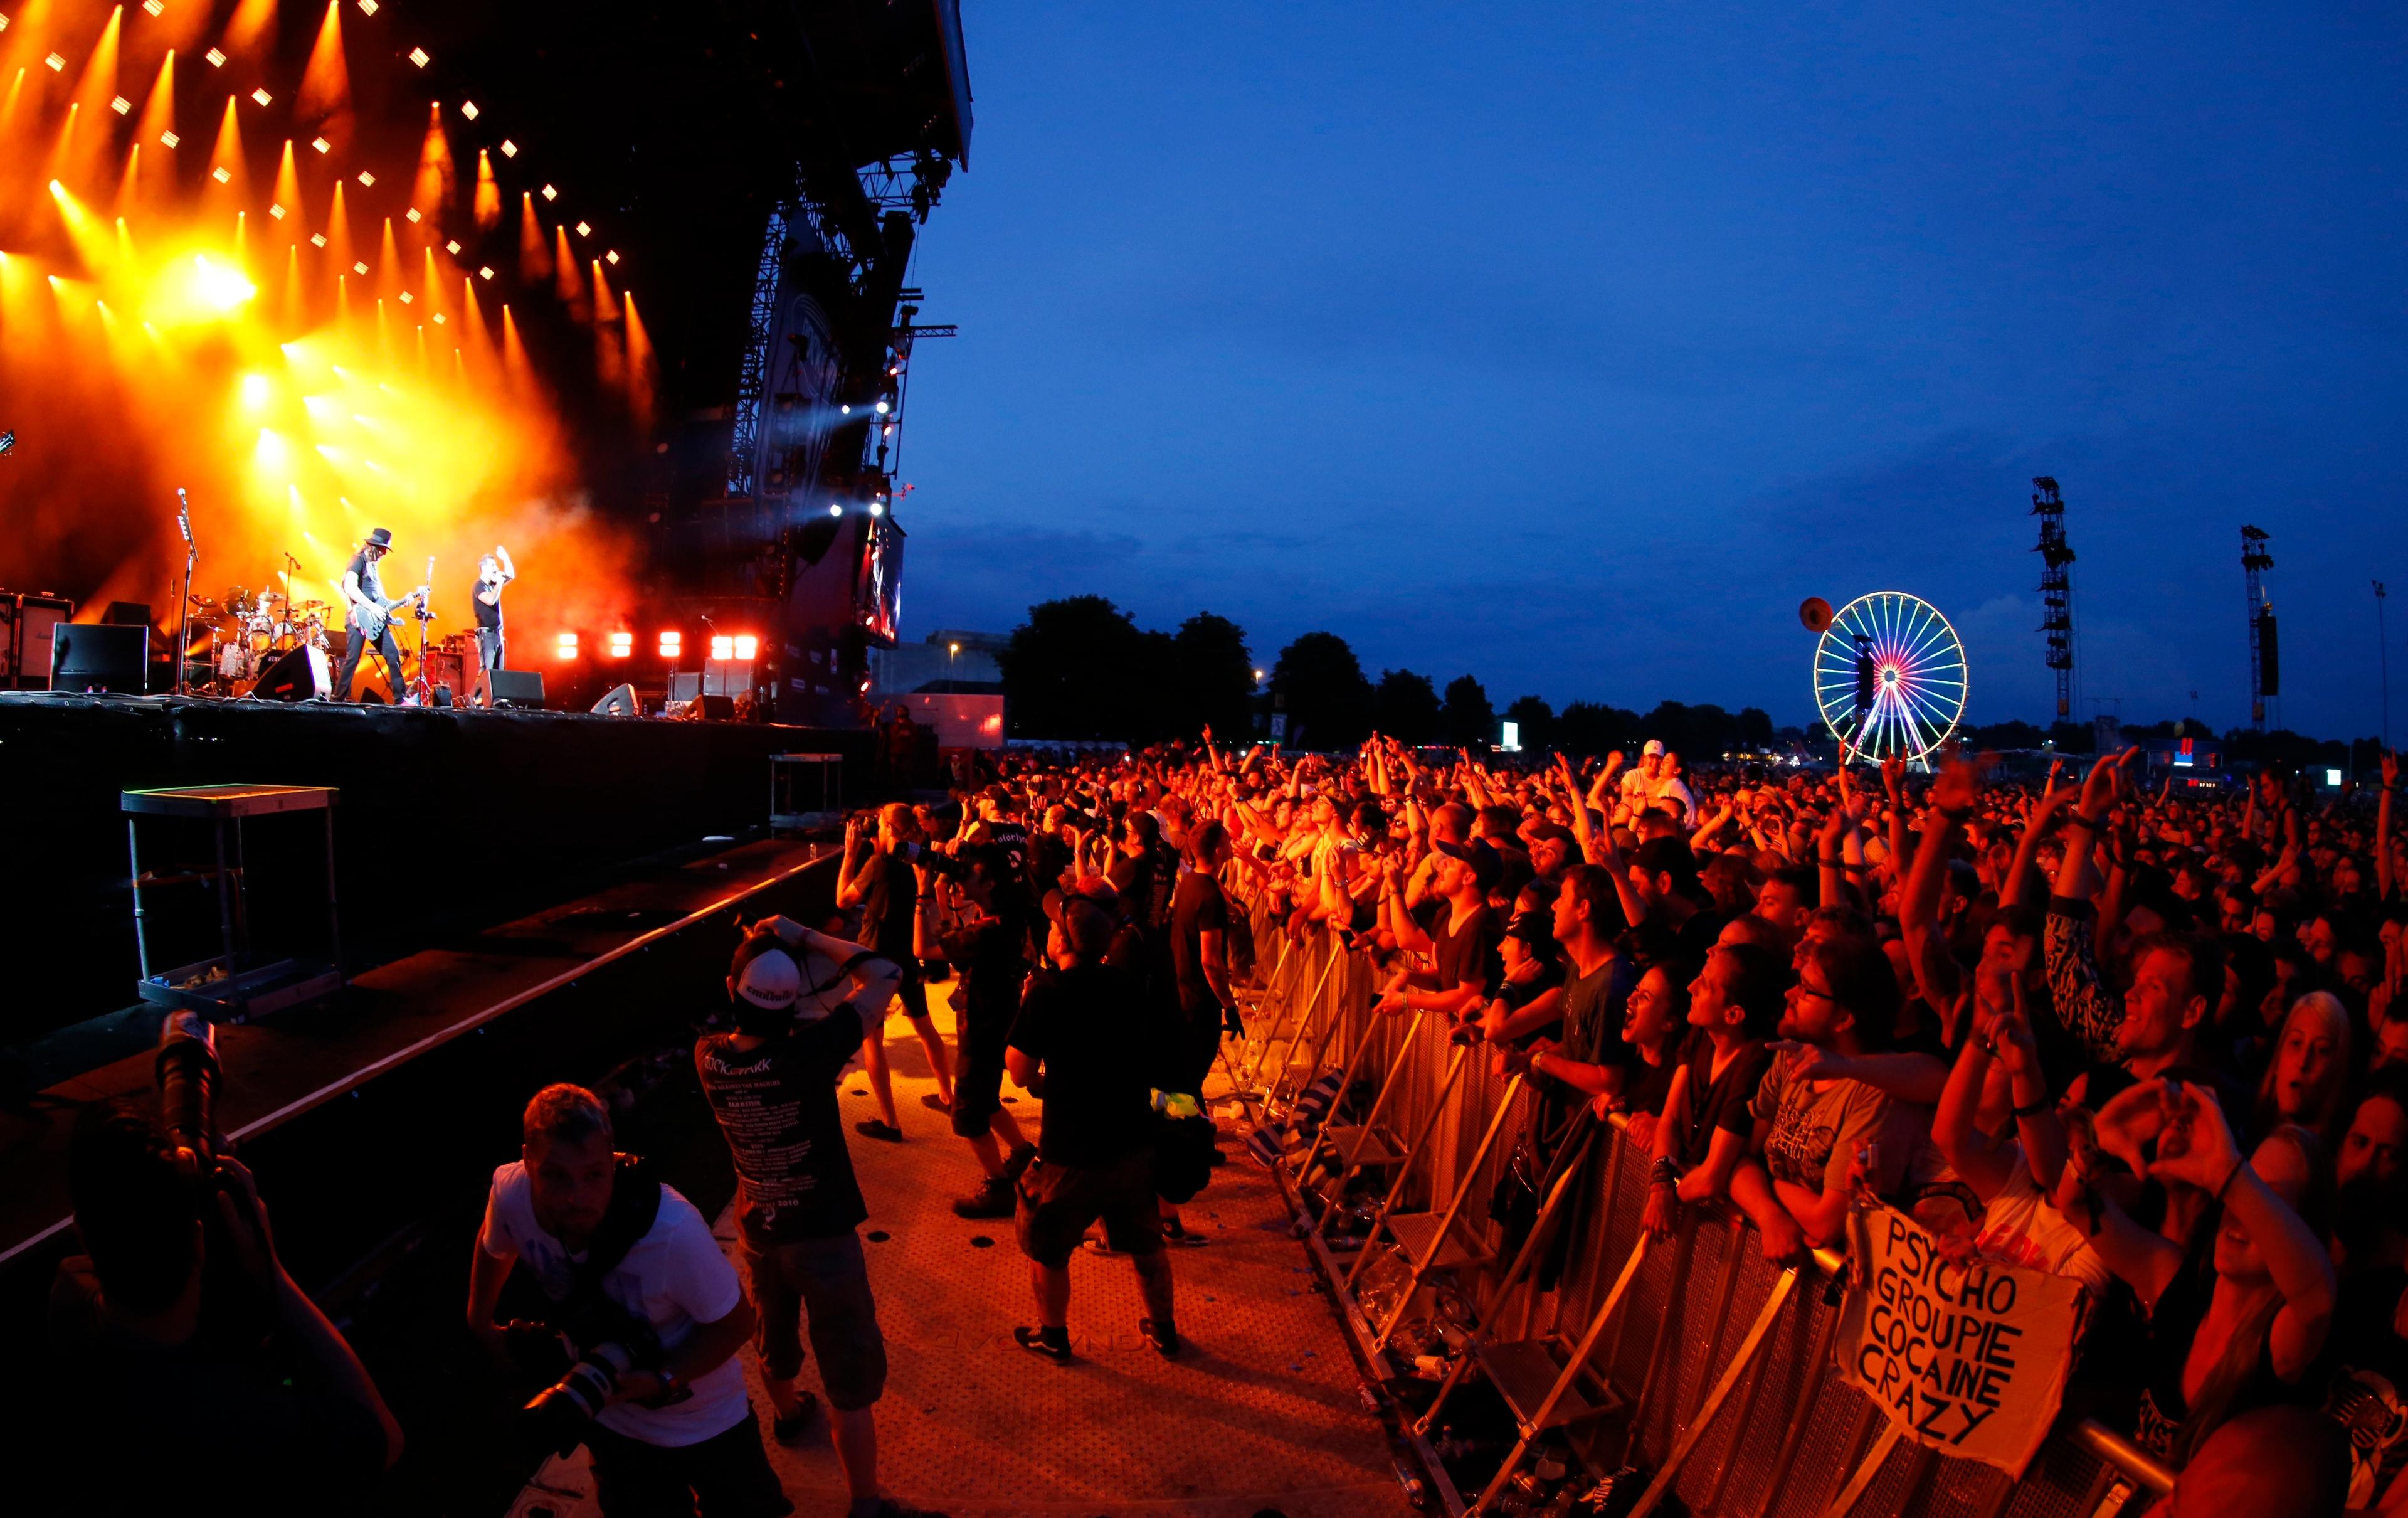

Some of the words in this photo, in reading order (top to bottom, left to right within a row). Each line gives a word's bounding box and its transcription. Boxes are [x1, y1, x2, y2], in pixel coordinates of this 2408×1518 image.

[1886, 1215, 2017, 1315] PSYCHO
[1870, 1307, 2012, 1408] COCAINE
[1877, 1267, 2023, 1369] GROUPIE
[1857, 1344, 1996, 1446] CRAZY
